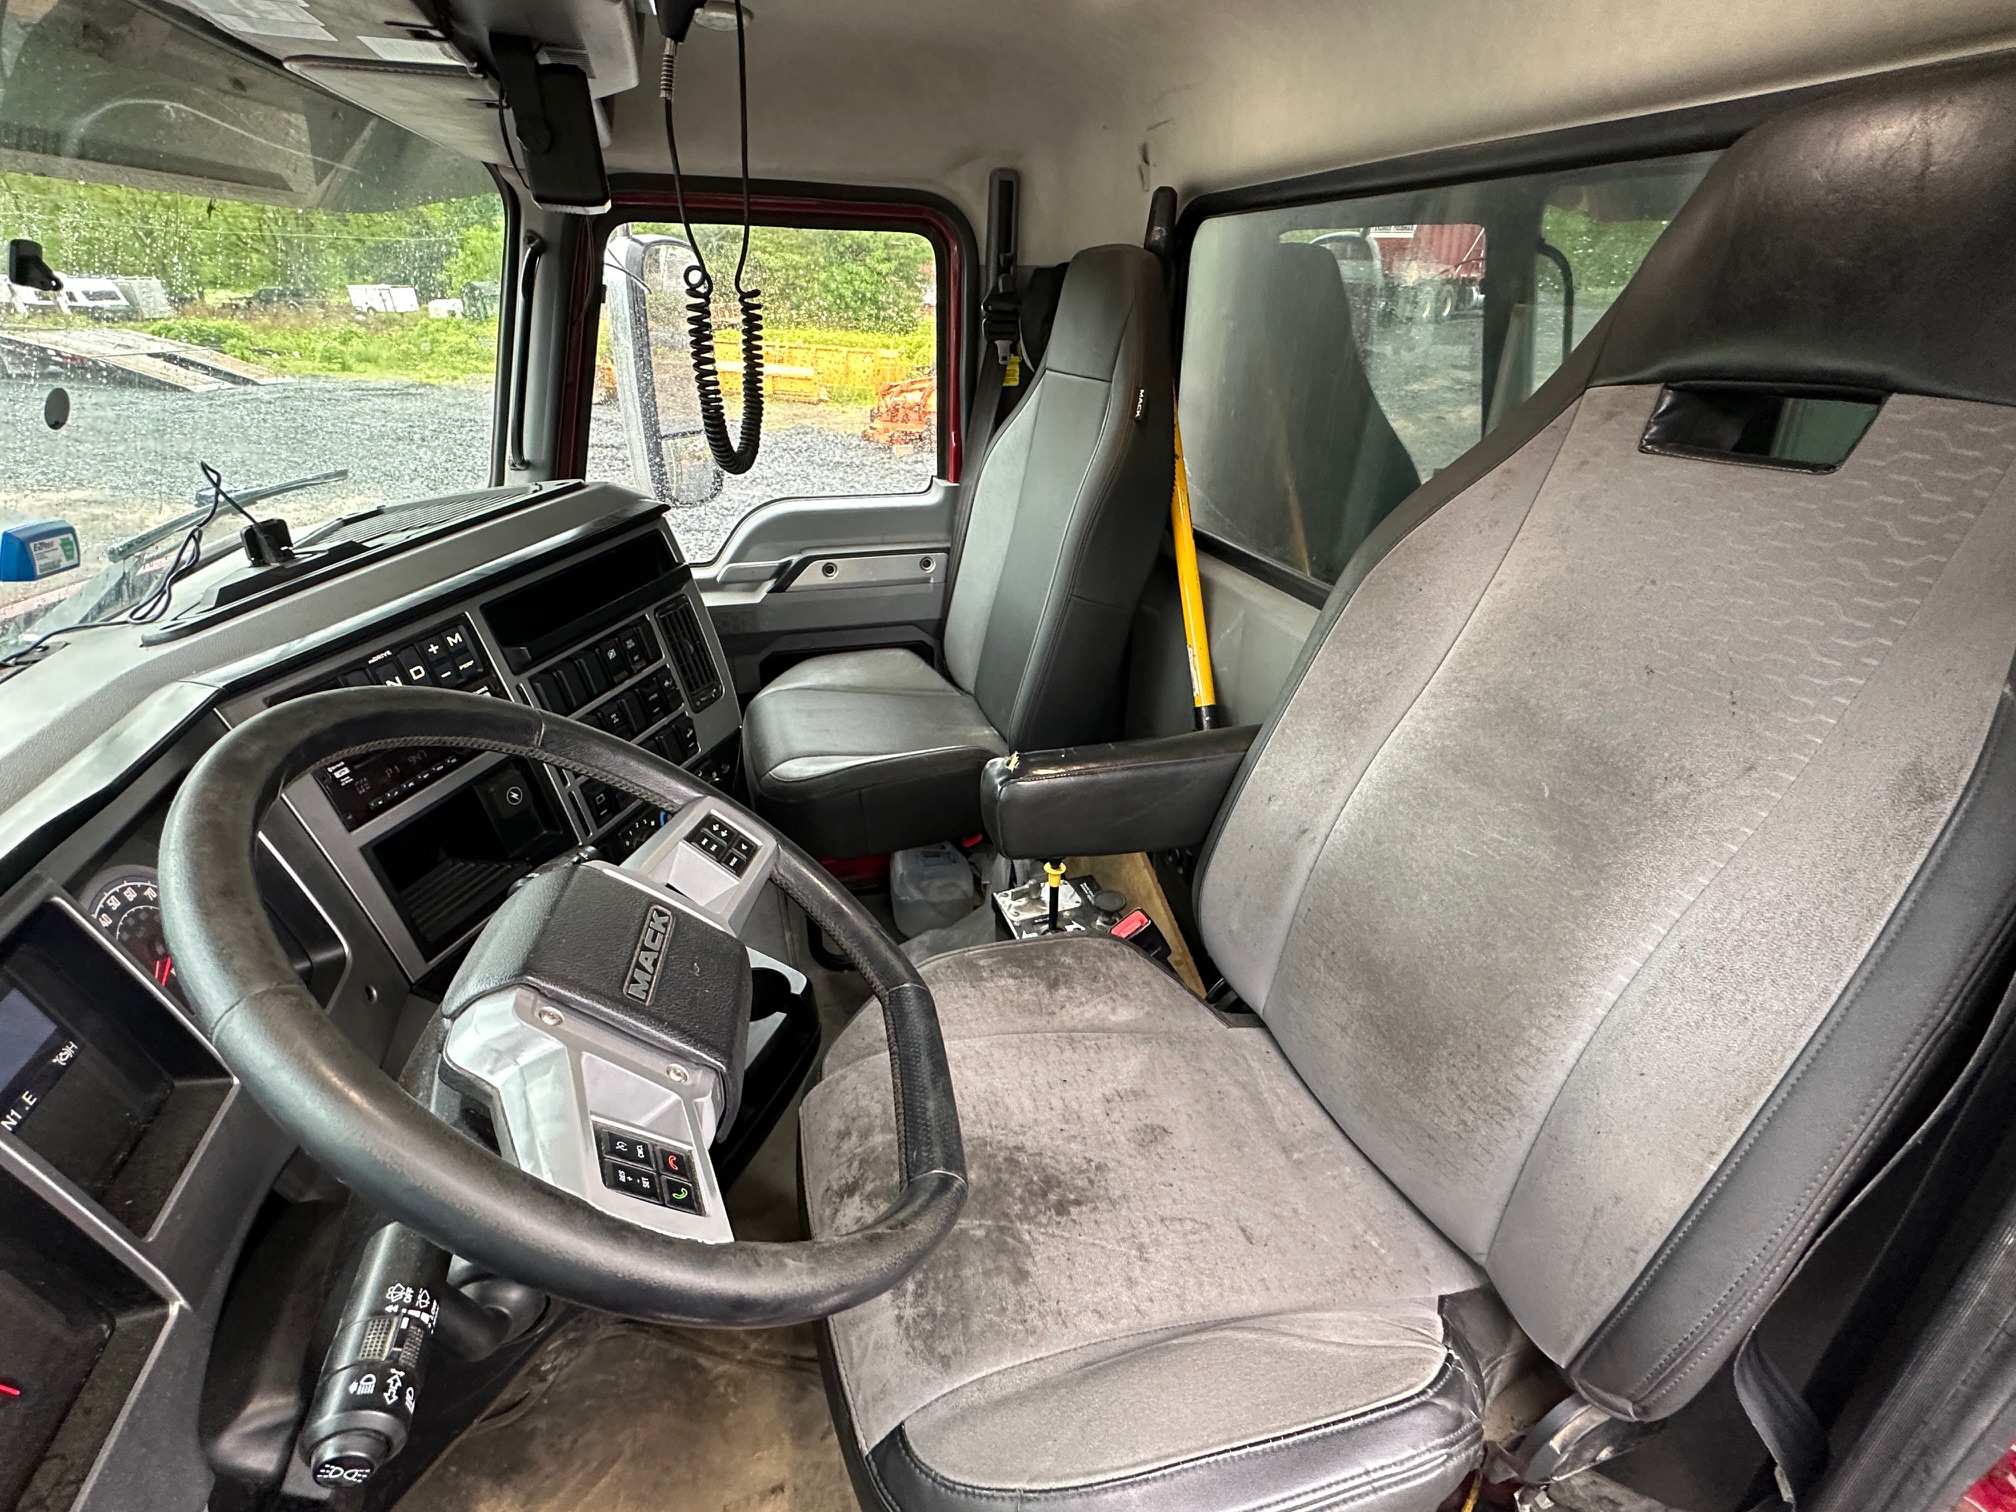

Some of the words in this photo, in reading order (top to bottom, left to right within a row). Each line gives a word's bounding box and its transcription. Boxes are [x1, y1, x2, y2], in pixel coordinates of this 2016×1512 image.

[1135, 389, 1145, 418] MACK
[446, 632, 463, 647] M
[409, 665, 426, 681] D
[385, 676, 402, 687] N
[123, 886, 138, 902] 60
[143, 886, 158, 901] 70
[106, 895, 121, 911] 50
[98, 913, 113, 928] 40
[628, 909, 670, 1000] MACK
[21, 1090, 38, 1106] E
[0, 1108, 22, 1132] N1
[641, 1176, 651, 1189] SET
[403, 1286, 415, 1304] OFF
